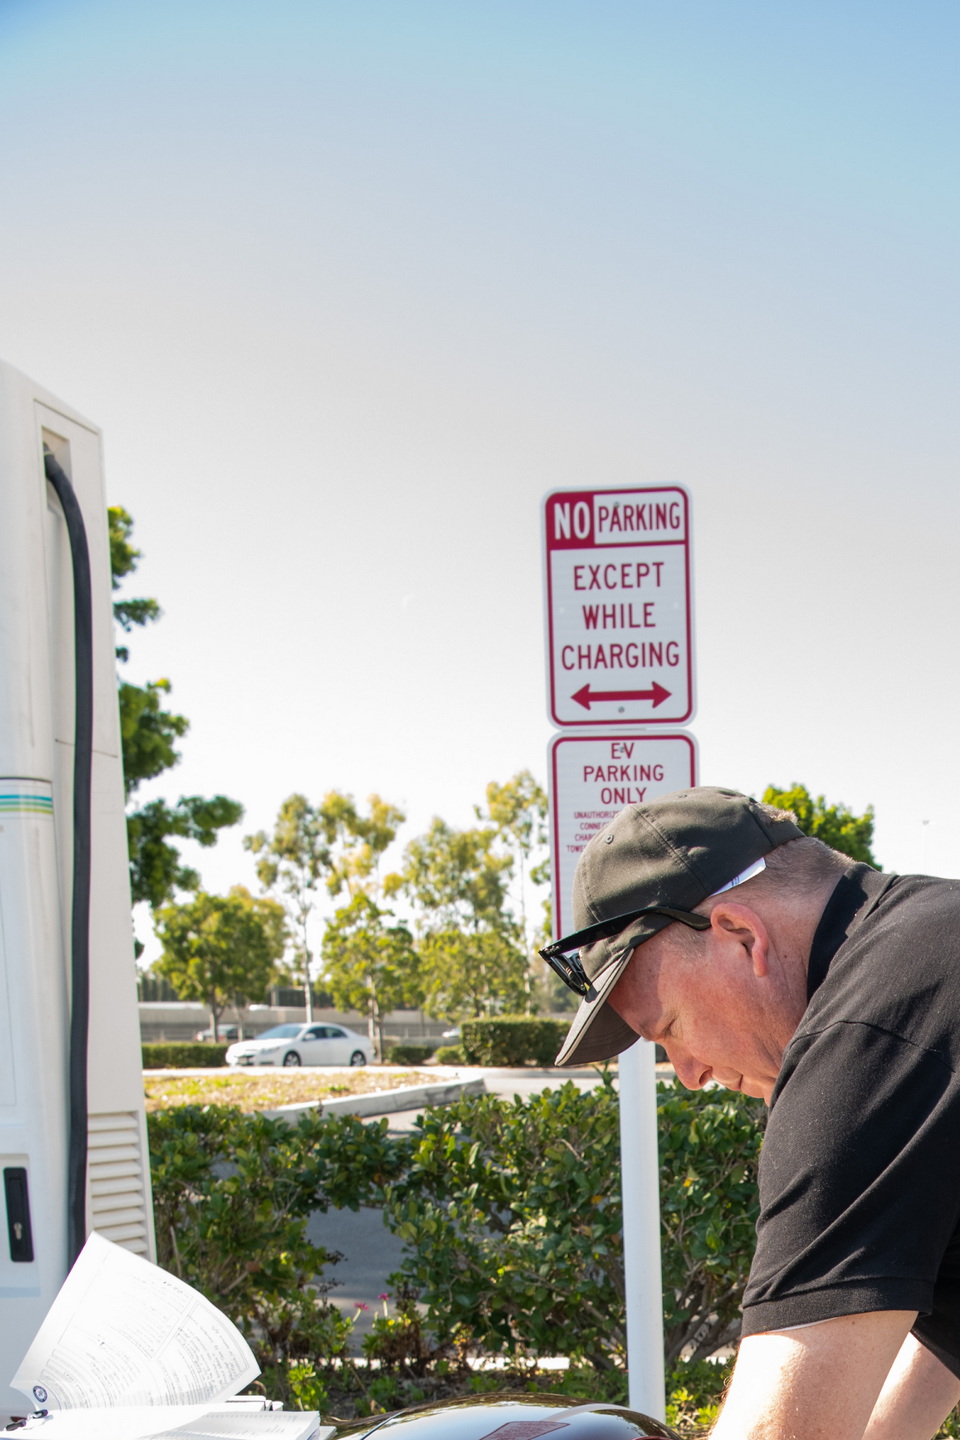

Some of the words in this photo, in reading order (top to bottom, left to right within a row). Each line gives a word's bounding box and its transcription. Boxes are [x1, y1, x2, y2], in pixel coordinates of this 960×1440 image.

[553, 501, 591, 540] NO
[598, 502, 681, 533] PARKING
[573, 562, 665, 591] EXCEPT
[582, 602, 657, 630] WHILE
[561, 641, 680, 671] CHARGING
[611, 742, 635, 760] EV
[583, 764, 665, 783] PARKING
[600, 787, 647, 805] ONLY
[574, 811, 619, 819] UNAUTHORIZ
[580, 822, 609, 830] CONNE
[575, 833, 595, 842] CHAR
[566, 844, 587, 853] TOWE
